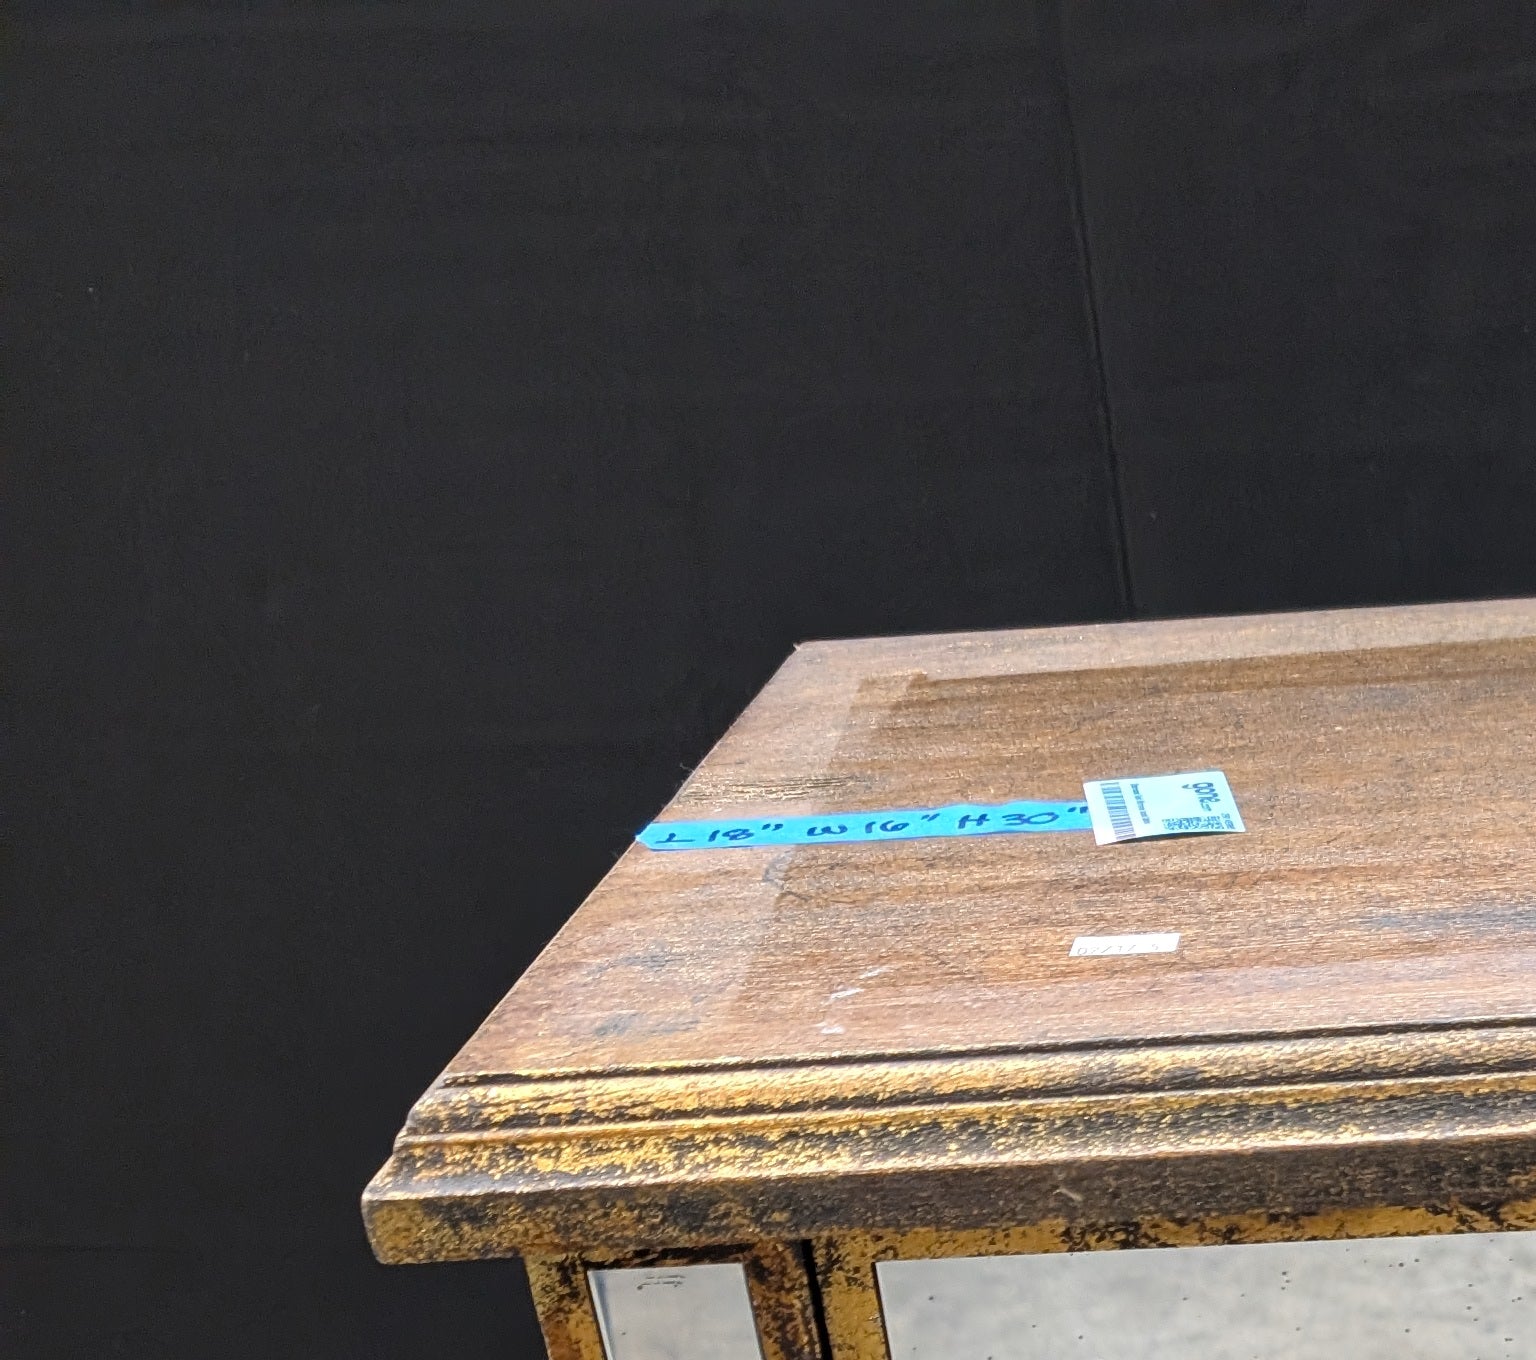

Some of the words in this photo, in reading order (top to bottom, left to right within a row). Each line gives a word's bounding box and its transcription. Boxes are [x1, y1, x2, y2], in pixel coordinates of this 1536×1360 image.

[707, 822, 785, 843] 18"
[864, 812, 941, 834] 16"
[957, 812, 990, 830] H
